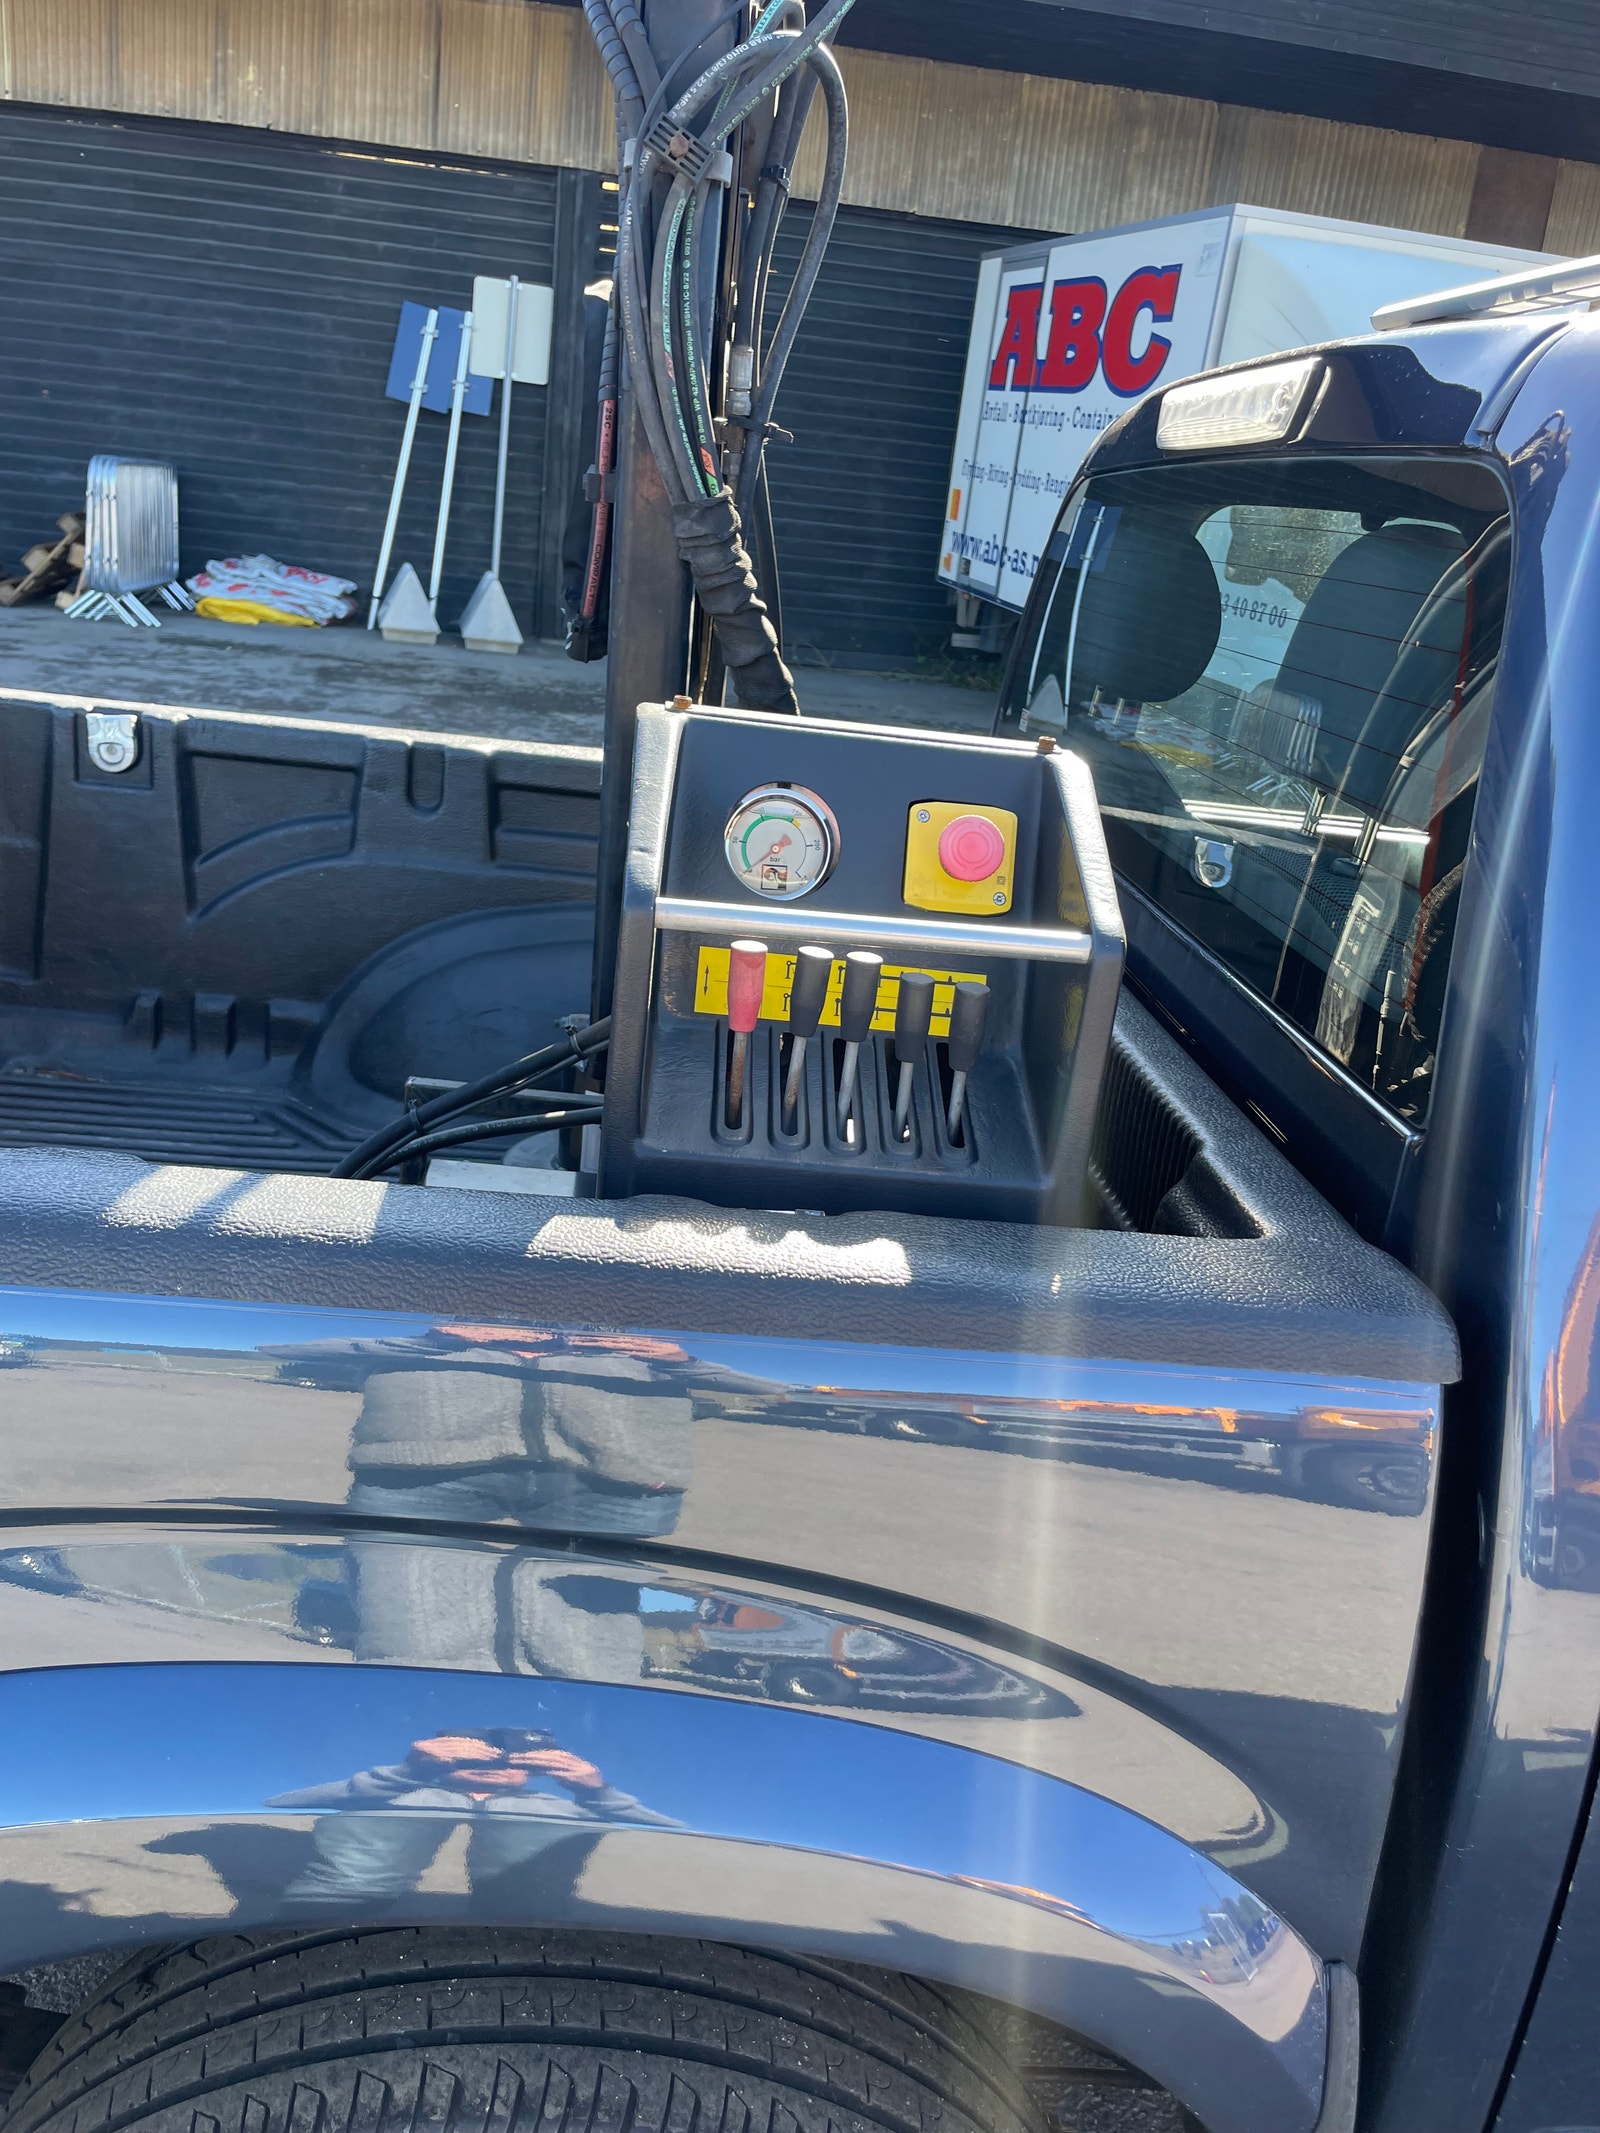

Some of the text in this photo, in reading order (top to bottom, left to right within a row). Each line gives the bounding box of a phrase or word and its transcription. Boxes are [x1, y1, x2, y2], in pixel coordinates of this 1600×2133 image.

[683, 302, 691, 326] MSHA
[988, 263, 1183, 399] ABC
[603, 407, 613, 429] 2SC
[1268, 605, 1288, 628] 00
